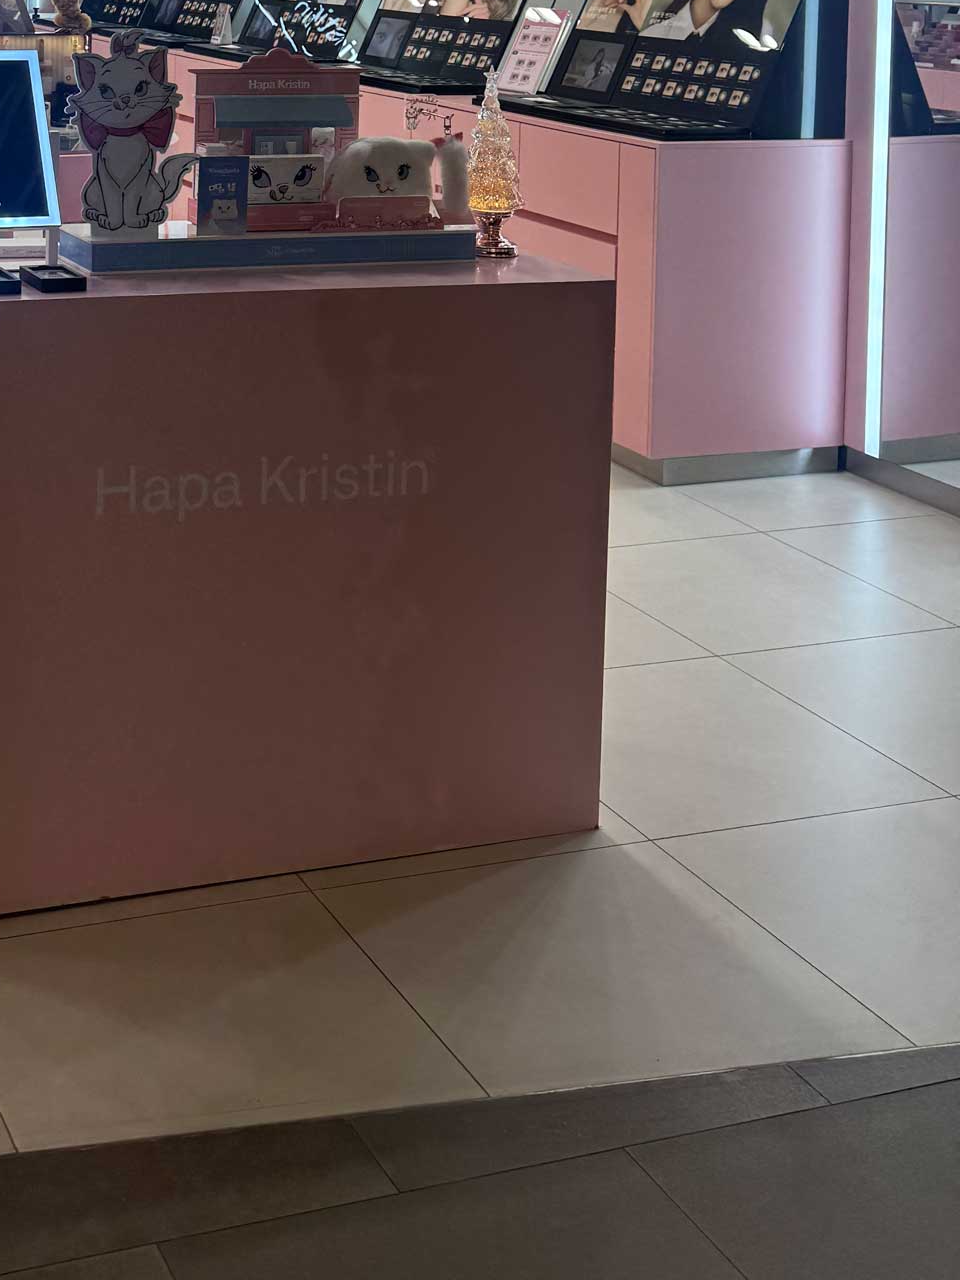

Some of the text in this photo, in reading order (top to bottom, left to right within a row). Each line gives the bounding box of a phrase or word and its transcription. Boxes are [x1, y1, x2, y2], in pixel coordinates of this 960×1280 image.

[248, 79, 311, 91] Hapa Kristin
[95, 449, 433, 523] Hapa Kristin
